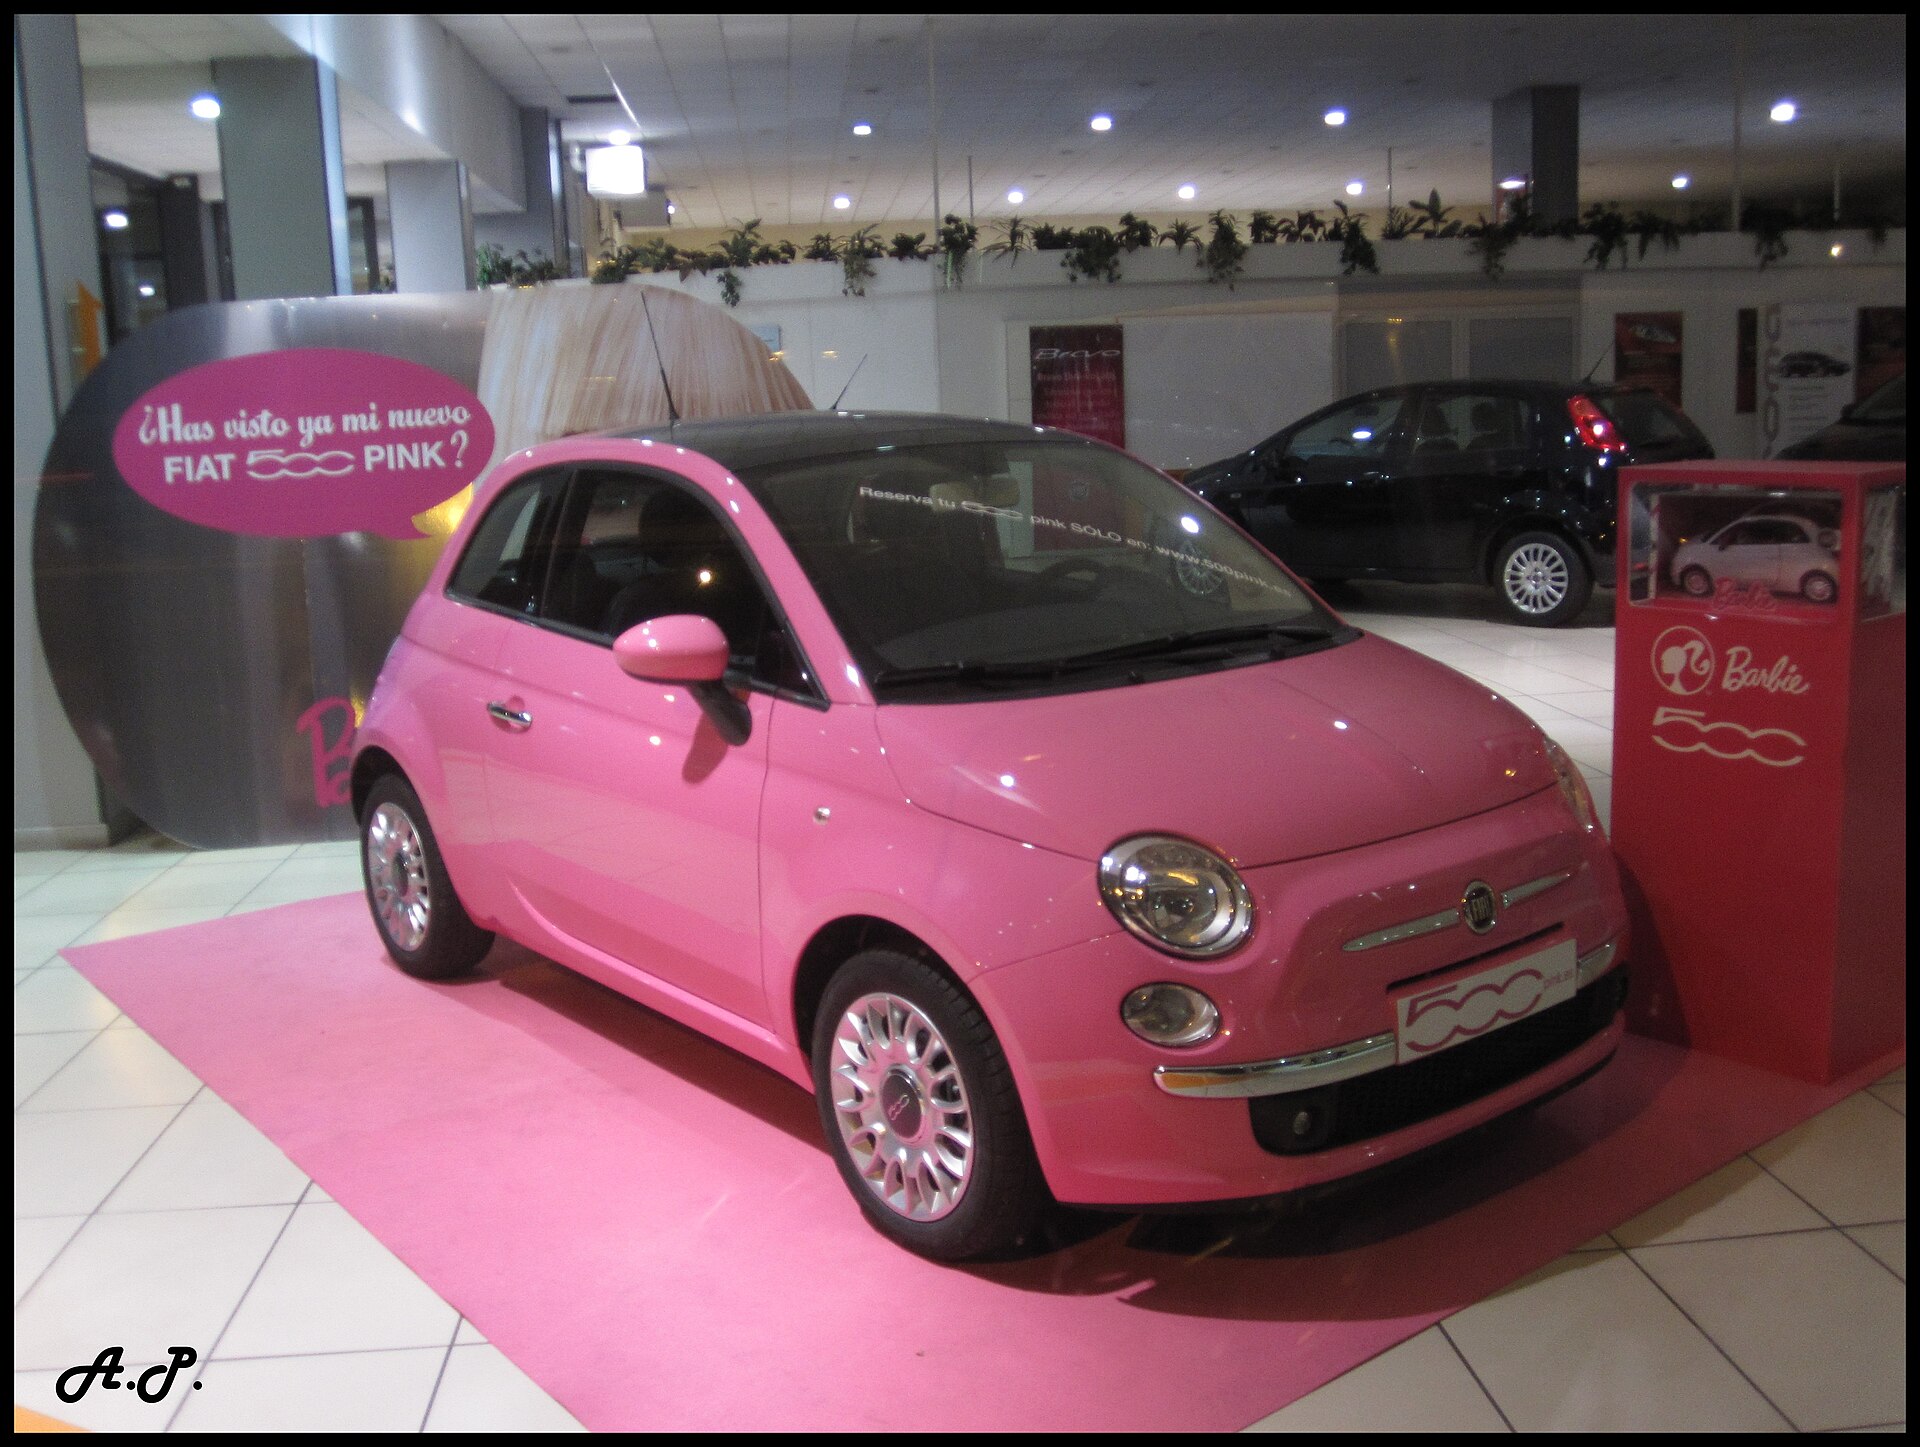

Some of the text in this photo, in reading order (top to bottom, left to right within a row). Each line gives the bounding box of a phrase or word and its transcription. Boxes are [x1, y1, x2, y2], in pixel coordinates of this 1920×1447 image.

[138, 402, 472, 448] ¿Has visto ya mi nuevo
[163, 453, 236, 485] FIAT
[246, 448, 356, 480] 500
[859, 486, 933, 506] Reserva
[938, 497, 957, 509] tu
[1030, 515, 1067, 530] pink
[1720, 645, 1810, 695] Barbie
[1651, 705, 1808, 768] 500
[1405, 967, 1544, 1054] 500
